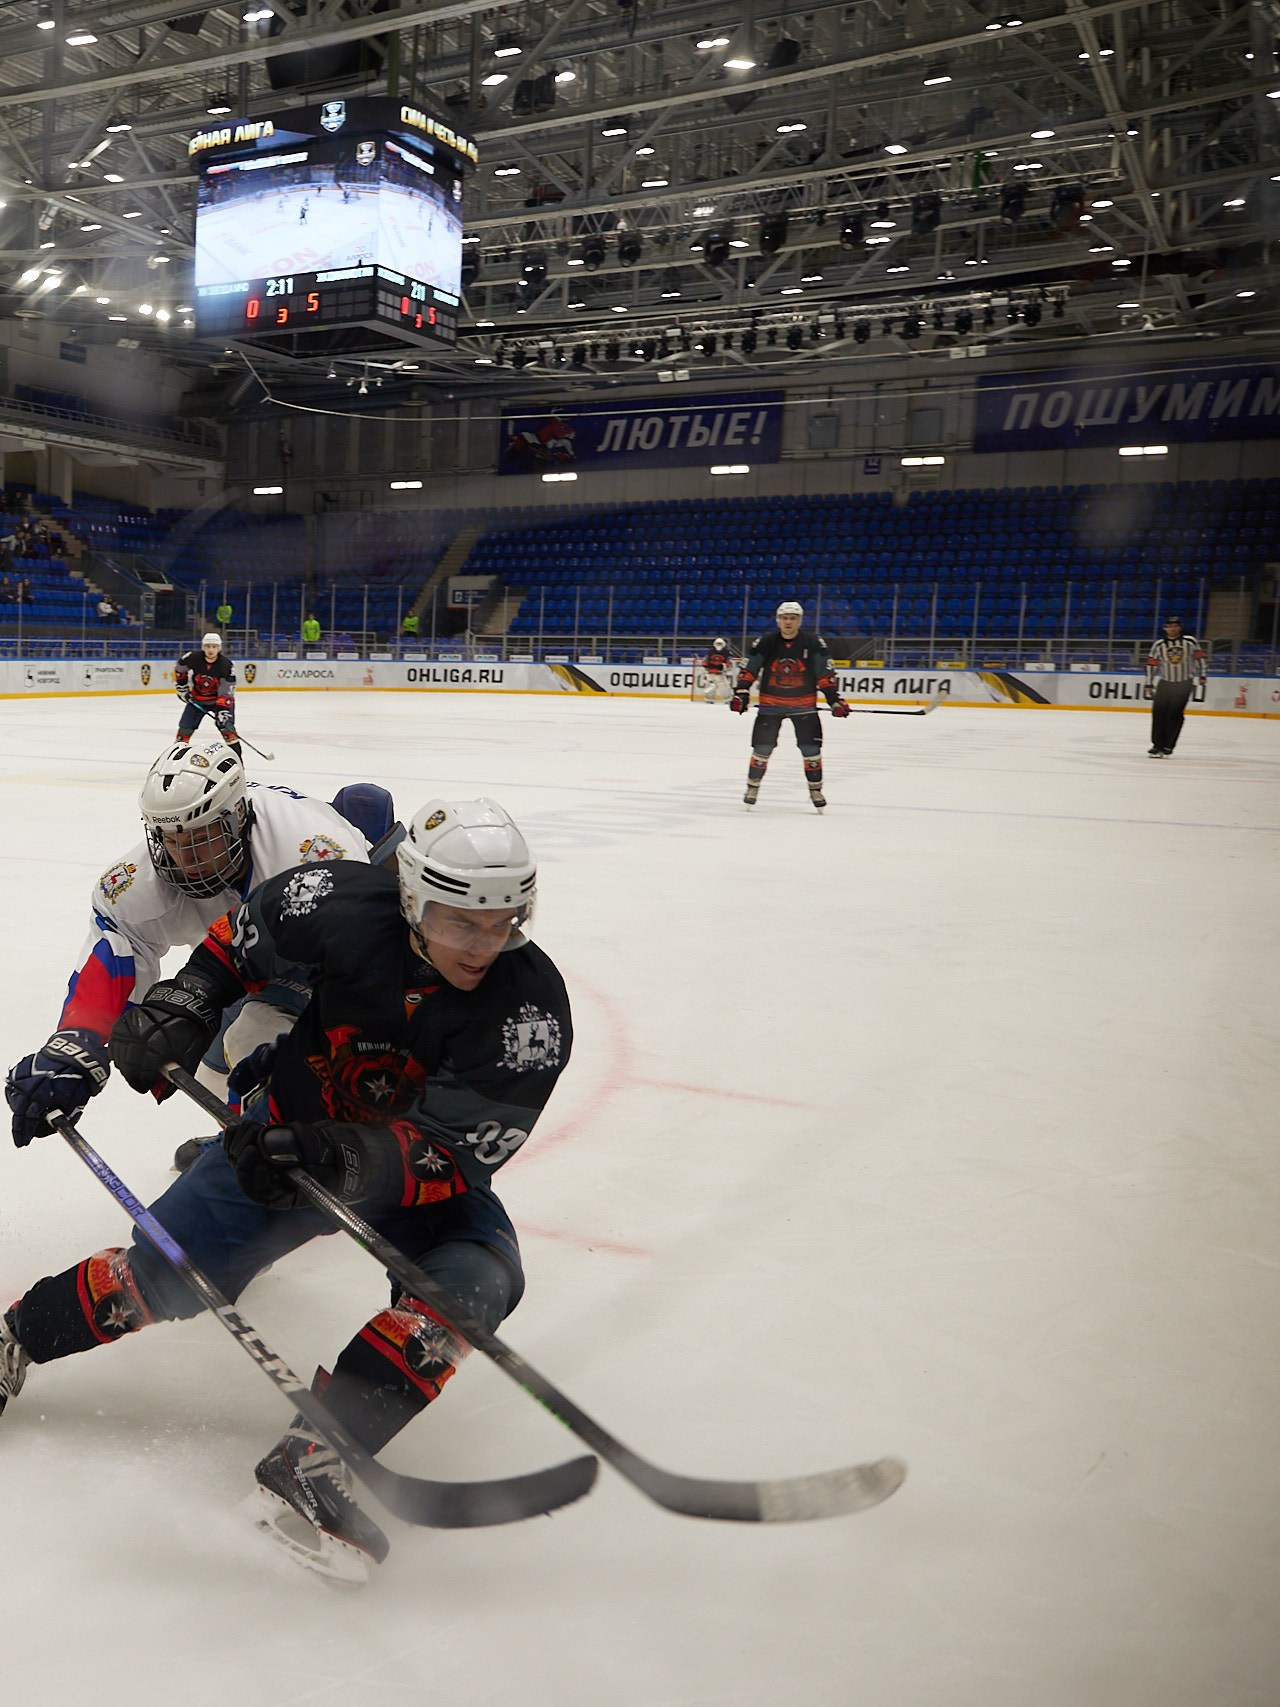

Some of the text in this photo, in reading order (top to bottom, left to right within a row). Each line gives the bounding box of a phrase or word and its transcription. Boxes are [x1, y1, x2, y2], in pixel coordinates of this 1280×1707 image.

[234, 120, 274, 142] ЛИГА
[266, 278, 293, 296] 2:11
[246, 292, 320, 324] 0 3 5
[597, 411, 768, 452] ЛЮТЫЕ!
[407, 668, 503, 683] OHLIGA.RU
[894, 678, 951, 695] ЛИГА
[152, 815, 181, 824] Reebok
[216, 1304, 311, 1397] CCM
[293, 1466, 318, 1508] BAUER
